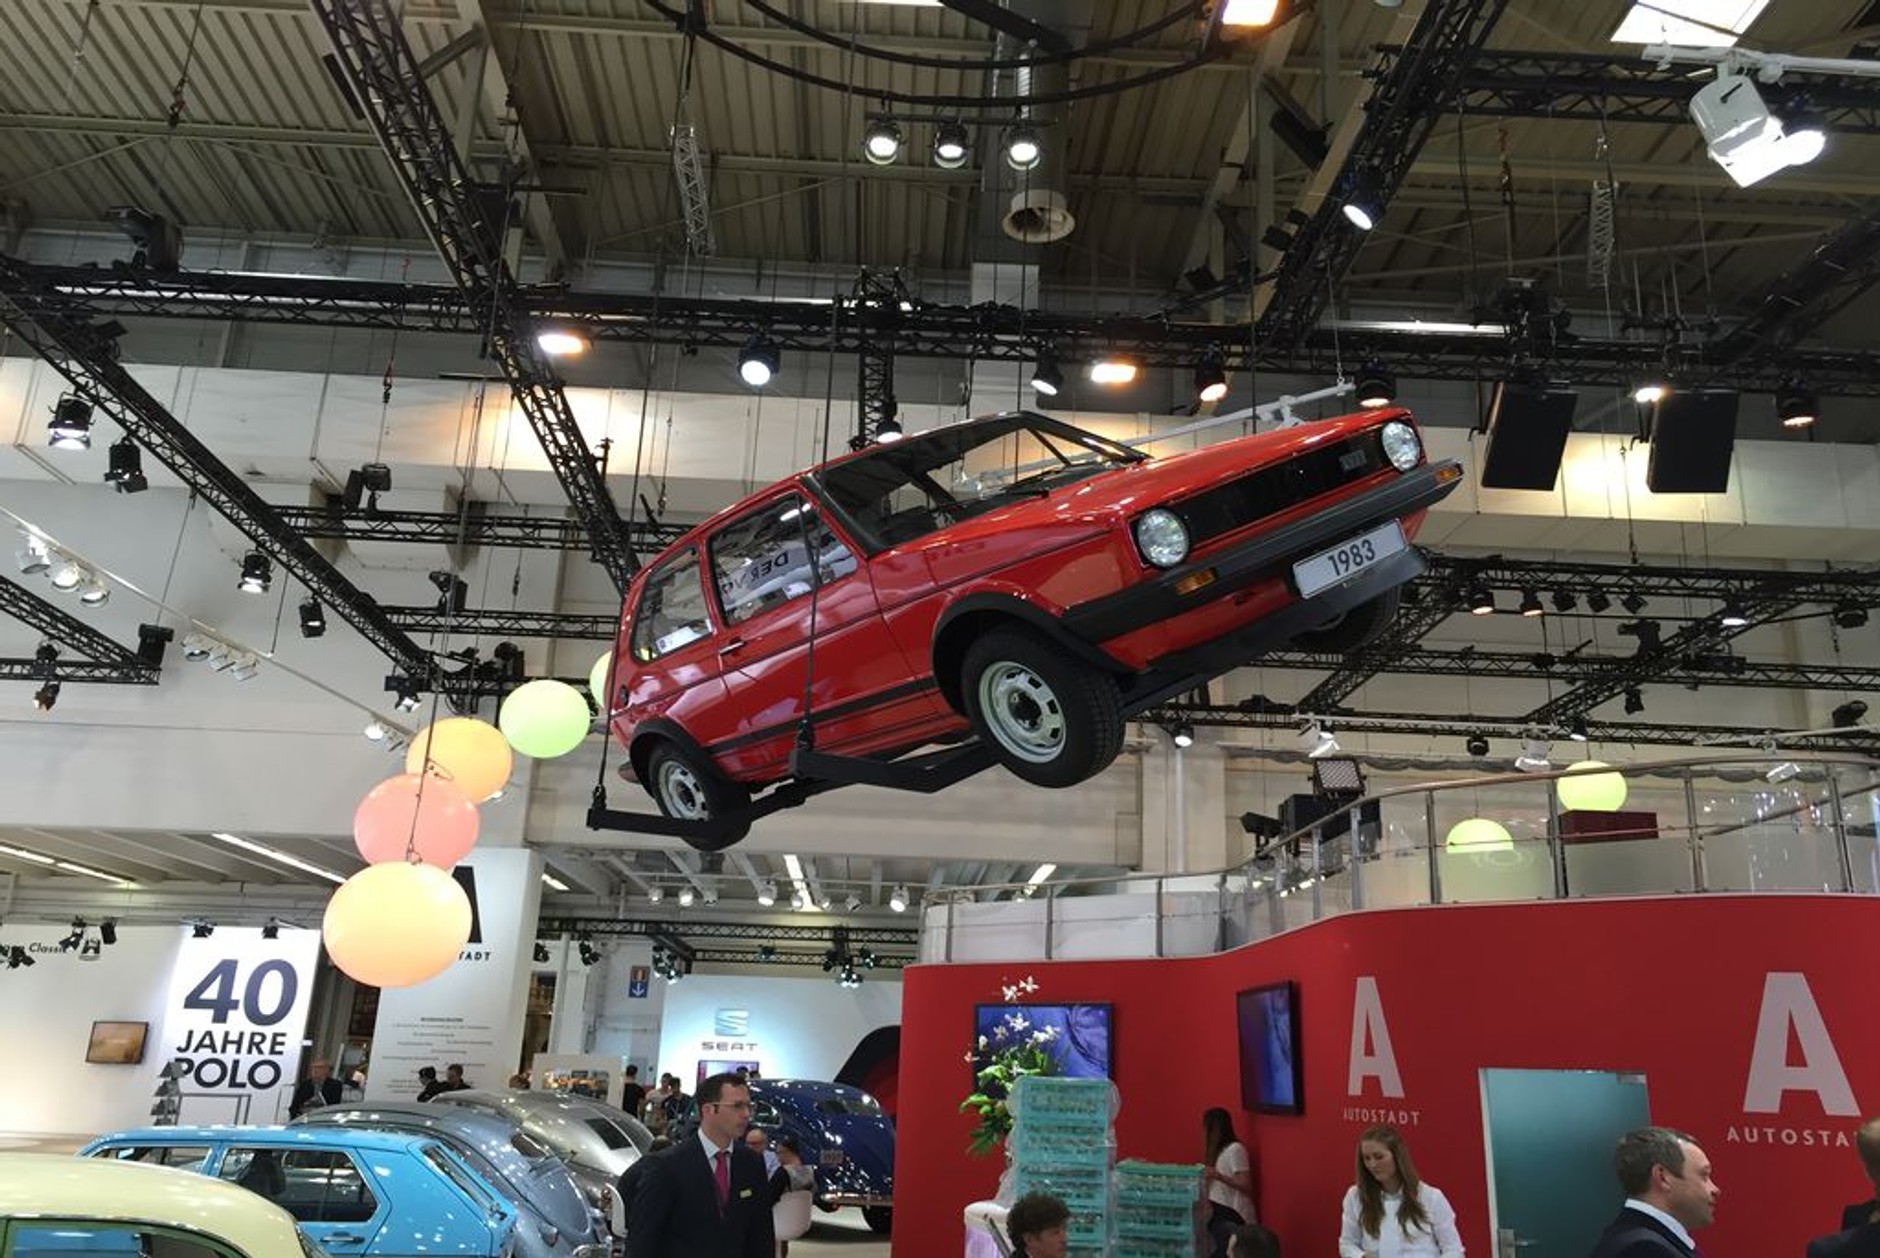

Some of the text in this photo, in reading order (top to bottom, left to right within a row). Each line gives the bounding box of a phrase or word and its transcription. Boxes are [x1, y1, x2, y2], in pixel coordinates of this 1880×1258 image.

[1327, 539, 1376, 576] 1983
[183, 958, 298, 1026] 40
[175, 1029, 287, 1056] JAHRE
[701, 1041, 758, 1051] SEAT
[1346, 975, 1406, 1099] A
[1742, 970, 1861, 1118] A
[1343, 1107, 1420, 1126] AUTOSTADT
[1727, 1125, 1857, 1147] AUTOSTA
